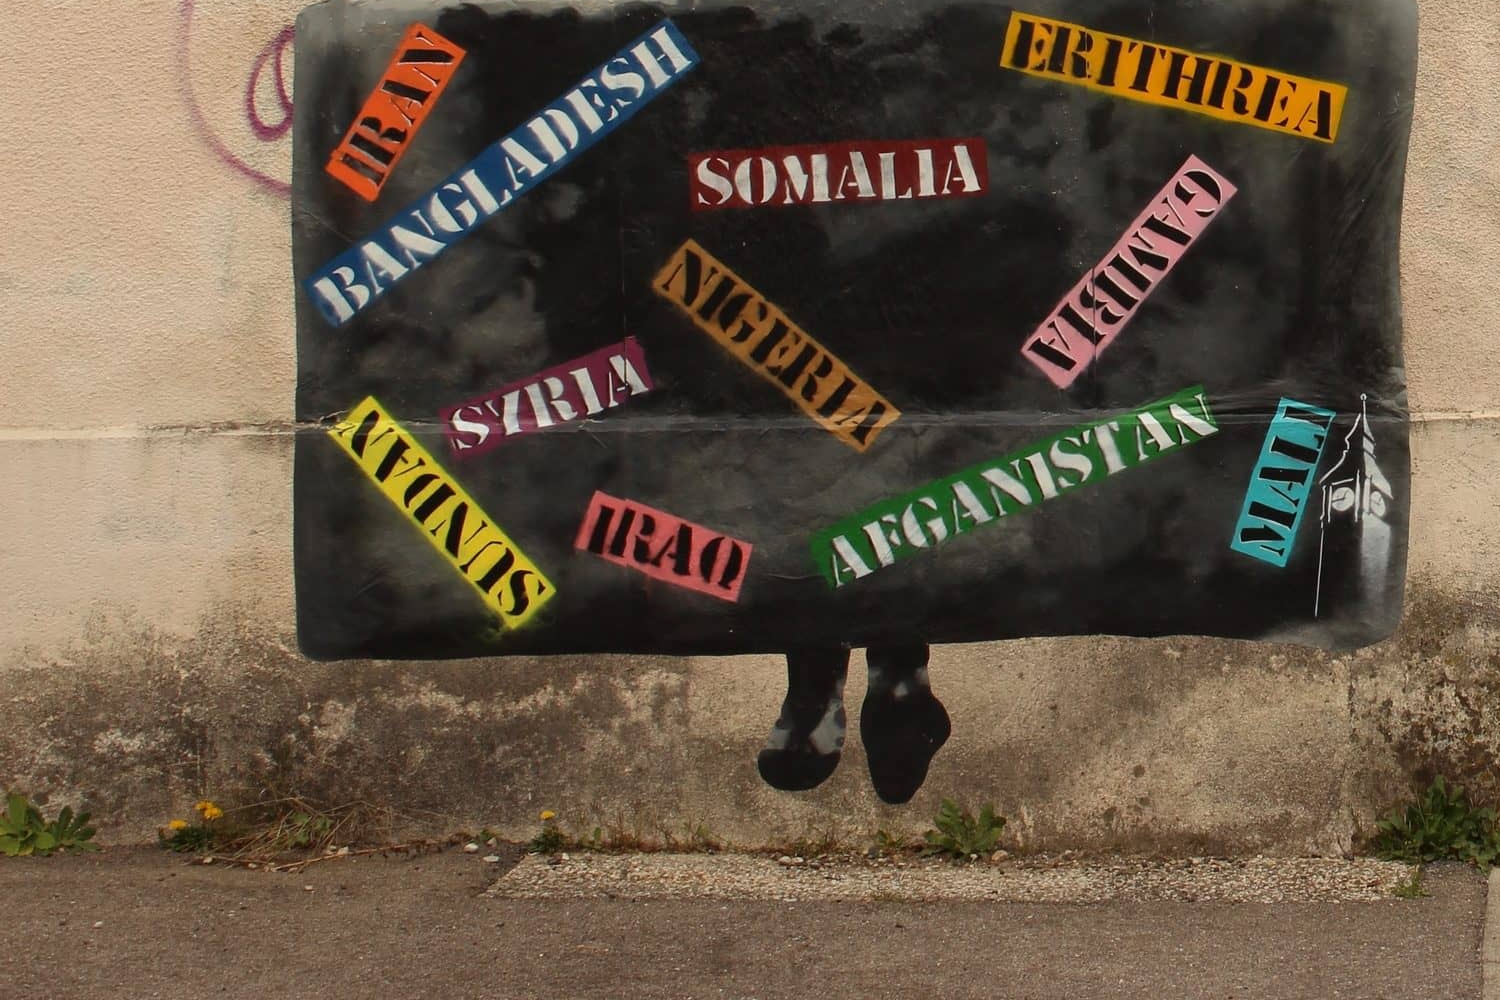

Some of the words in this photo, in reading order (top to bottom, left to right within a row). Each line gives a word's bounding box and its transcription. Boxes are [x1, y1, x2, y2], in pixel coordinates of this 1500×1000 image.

[339, 31, 456, 187] IRAN
[1010, 18, 1334, 140] ERITHREA
[312, 24, 693, 324] BANGLADESH
[696, 145, 982, 206] SOMALIA
[661, 246, 881, 446] NIGERIA
[1029, 166, 1225, 373] GAMBIA
[449, 353, 649, 451] SYRIA
[336, 410, 546, 617] SUNDAN
[588, 506, 748, 591] IRAQ
[832, 393, 1219, 588] AFGANISTAN
[1239, 406, 1332, 558] MALI
